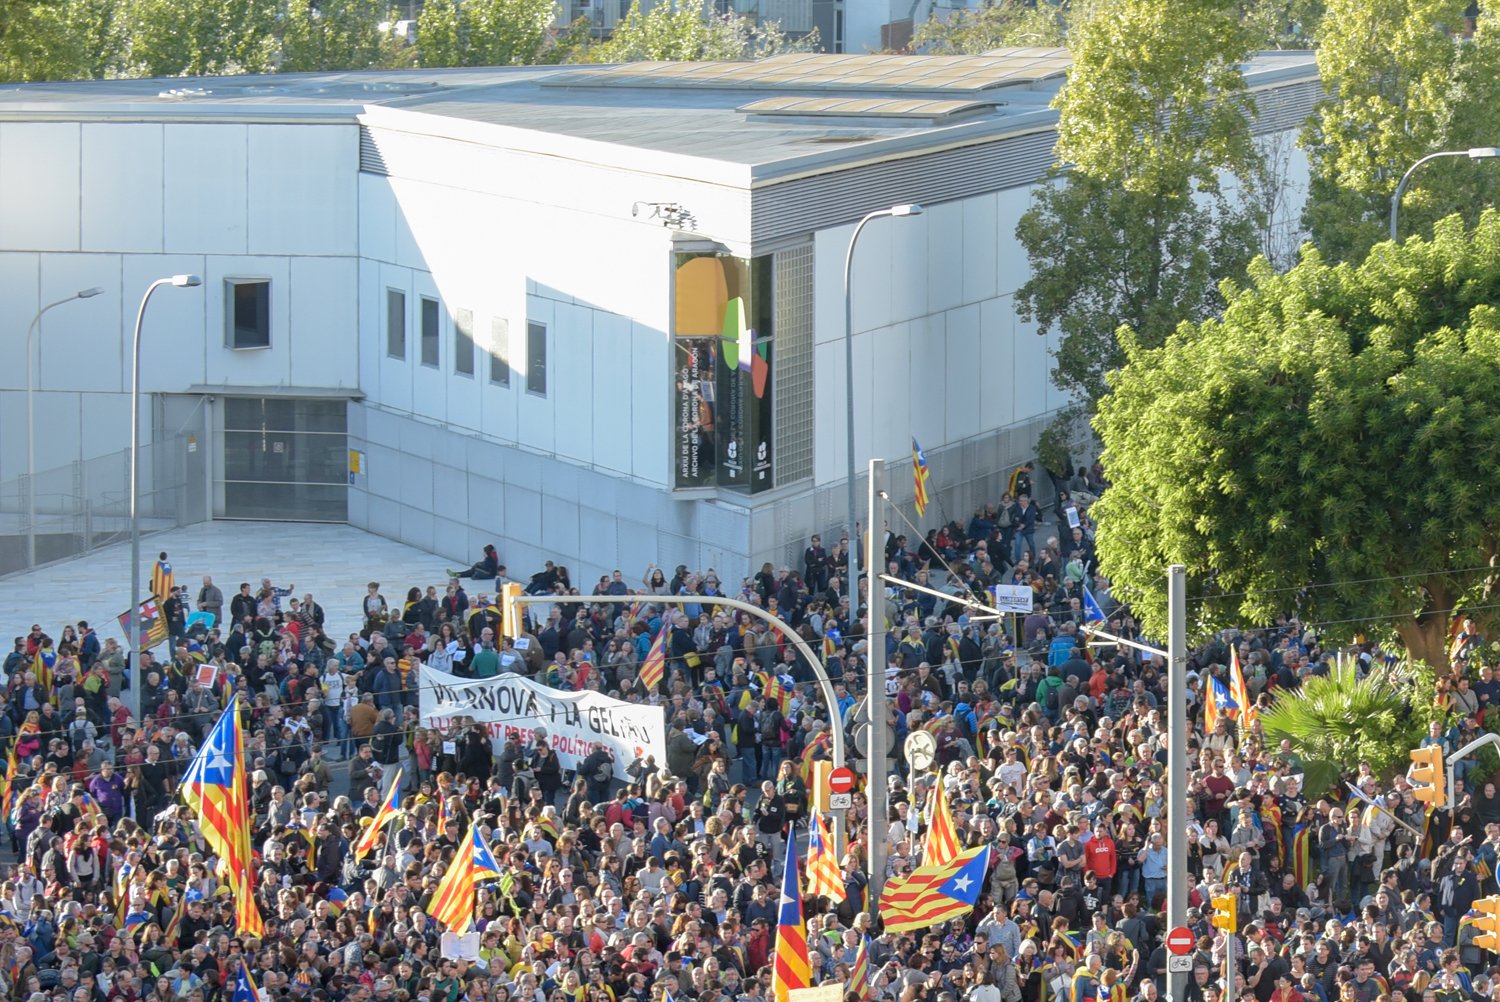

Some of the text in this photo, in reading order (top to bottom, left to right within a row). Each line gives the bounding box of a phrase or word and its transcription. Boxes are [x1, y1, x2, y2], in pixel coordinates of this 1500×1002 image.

[682, 434, 689, 443] LA
[691, 433, 698, 444] DE
[682, 445, 689, 454] DE
[560, 701, 582, 728] LA
